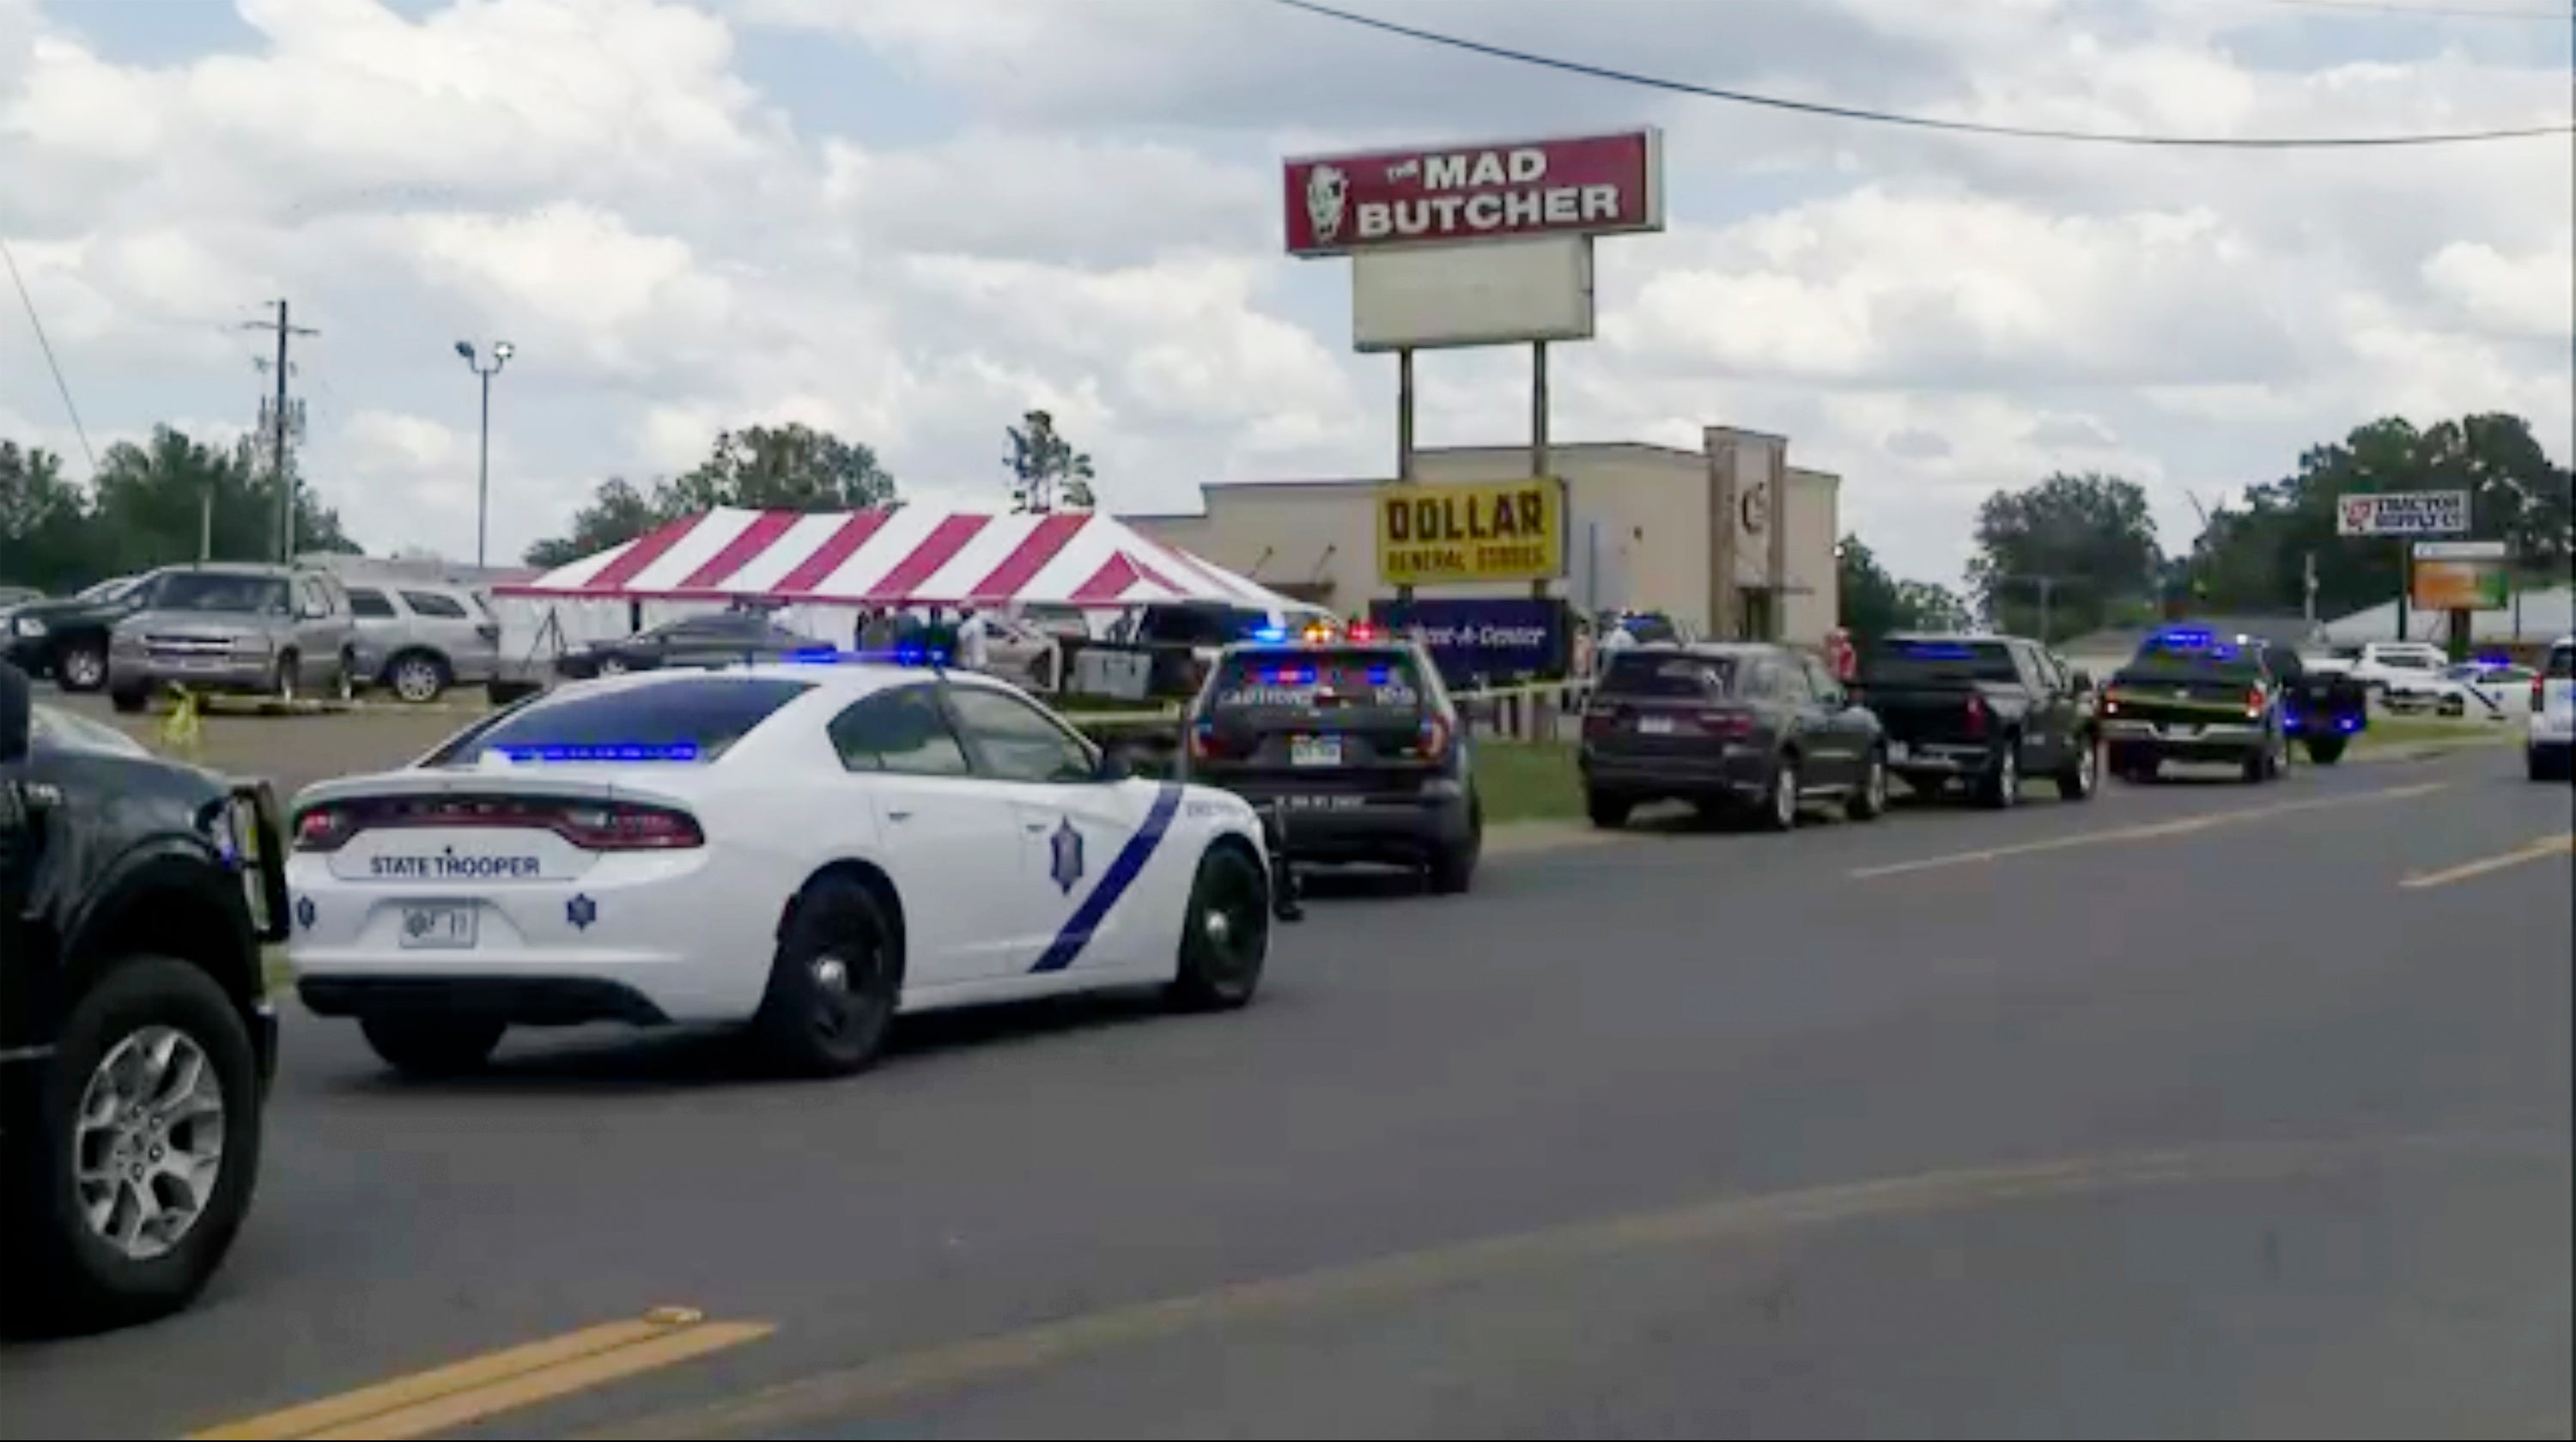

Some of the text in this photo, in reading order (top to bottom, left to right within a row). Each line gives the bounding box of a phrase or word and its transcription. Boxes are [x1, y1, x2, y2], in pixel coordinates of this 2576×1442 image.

[1423, 148, 1546, 190] MAD
[1357, 184, 1620, 237] BUTCHER
[1387, 490, 1546, 541] DOLLAR
[370, 857, 541, 877] STATE TROOPER
